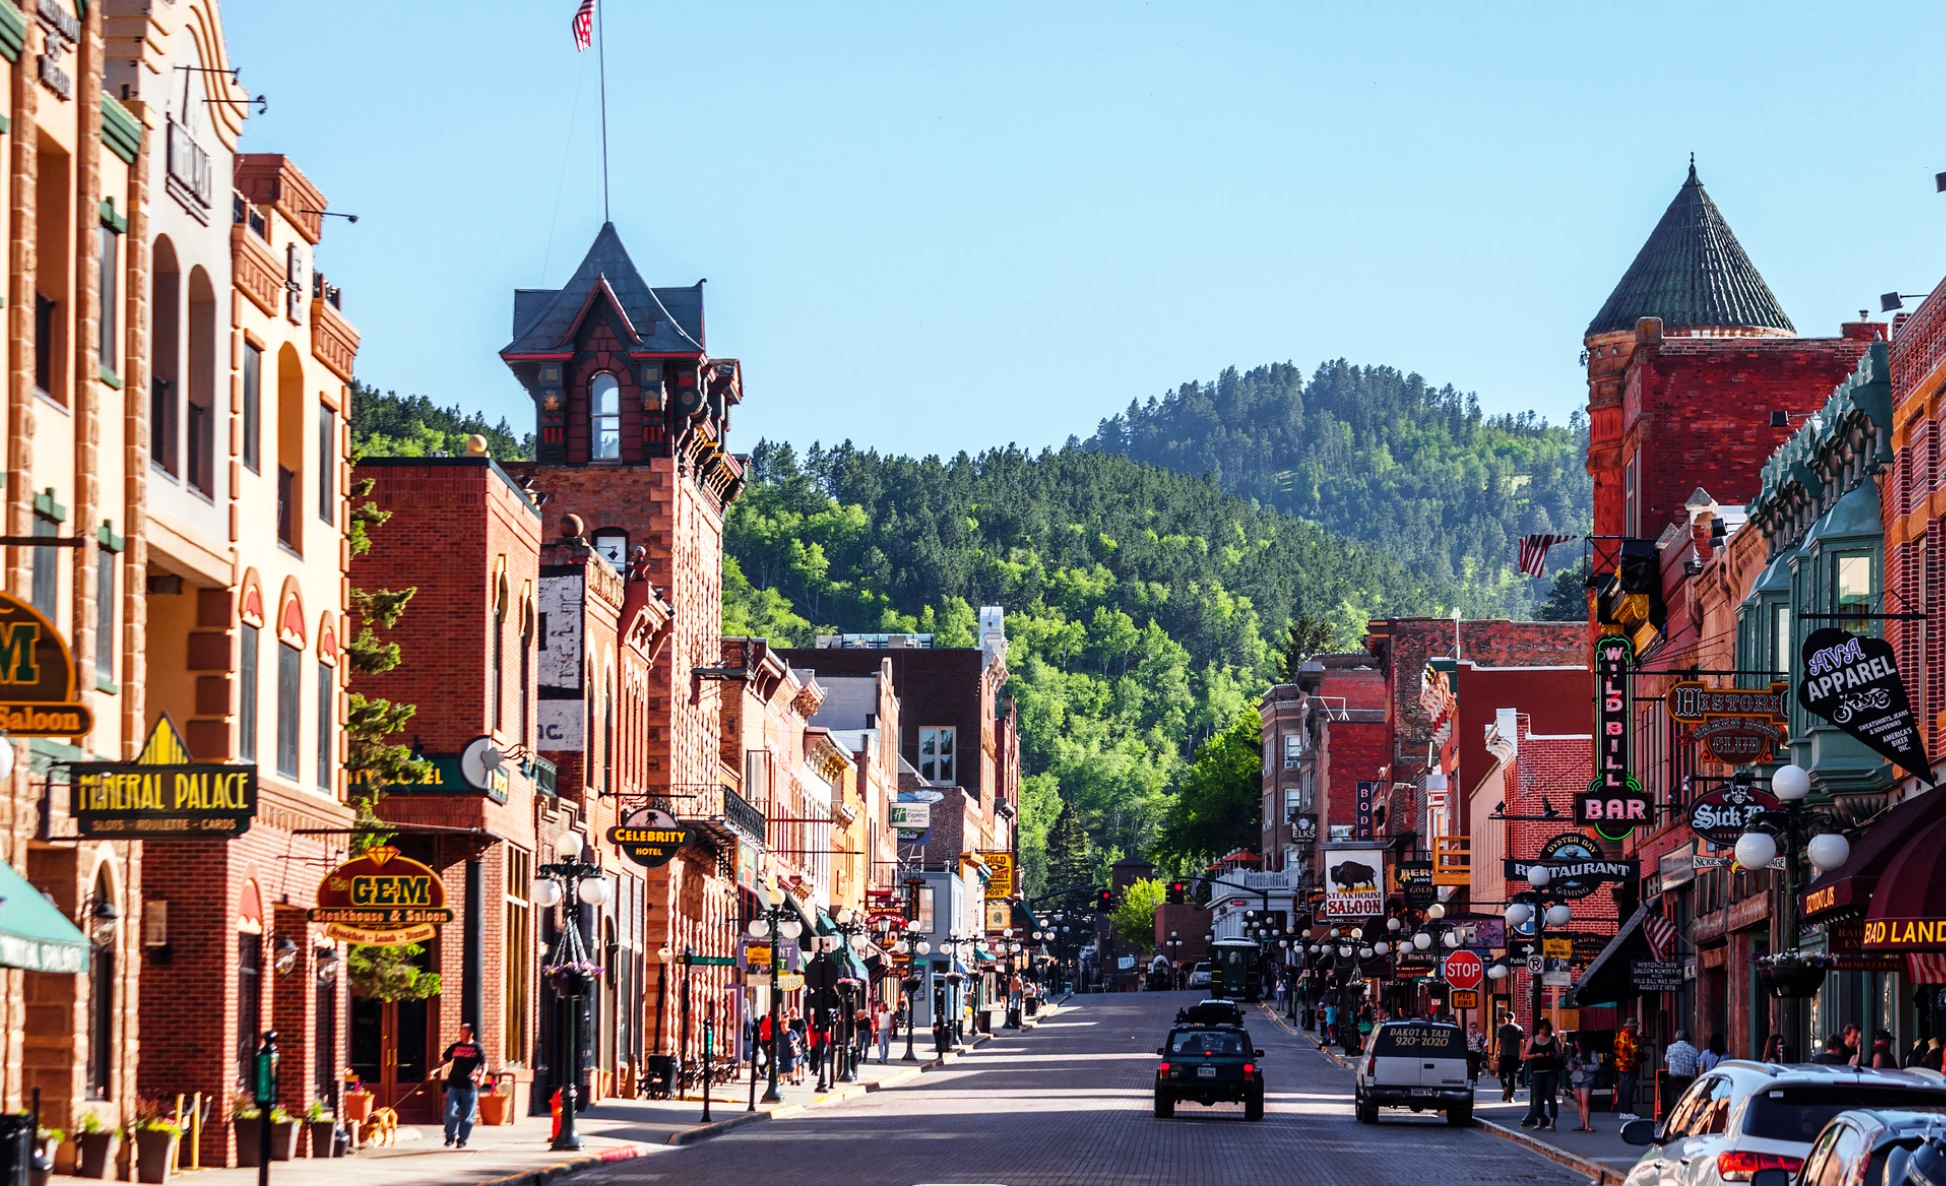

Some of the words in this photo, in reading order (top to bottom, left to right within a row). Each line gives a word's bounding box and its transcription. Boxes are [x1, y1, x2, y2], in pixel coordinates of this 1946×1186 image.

[1809, 637, 1866, 676] AVA
[1605, 647, 1623, 712] WILD
[1807, 655, 1896, 702] APPAREL
[0, 706, 80, 731] Saloon
[1893, 709, 1909, 720] JEANS
[1693, 717, 1741, 740] GREEN
[1874, 720, 1902, 734] SOUVENIRS
[1882, 727, 1913, 743] AMERICA'S
[1891, 736, 1909, 748] BIKER
[1713, 737, 1760, 753] CLUB
[1898, 743, 1911, 753] INC.
[1606, 721, 1623, 787] BILL
[79, 774, 165, 810] MINERAL
[174, 773, 249, 809] PALACE
[1585, 799, 1646, 820] BAR
[1692, 804, 1741, 830] Sick
[92, 819, 125, 831] SLOTS
[135, 819, 190, 831] ROULETTE
[201, 819, 237, 830] CARDS
[614, 828, 686, 843] CELEBRITY
[1292, 829, 1315, 838] ELKS
[635, 847, 663, 856] HOTEL
[1548, 836, 1579, 853] OYSTER
[984, 856, 1006, 864] GOLD
[1515, 863, 1630, 878] RTAURANT
[352, 875, 431, 906] GEM
[1555, 886, 1589, 897] GAMING
[1328, 900, 1382, 914] SALOON
[312, 910, 384, 922] Steakhouse
[389, 910, 402, 922] &
[406, 910, 448, 922] Saloon
[1864, 922, 1886, 944] BAD
[1447, 963, 1480, 977] STOP
[1431, 1029, 1451, 1038] TAXI
[1395, 1036, 1449, 1047] 920-2020
